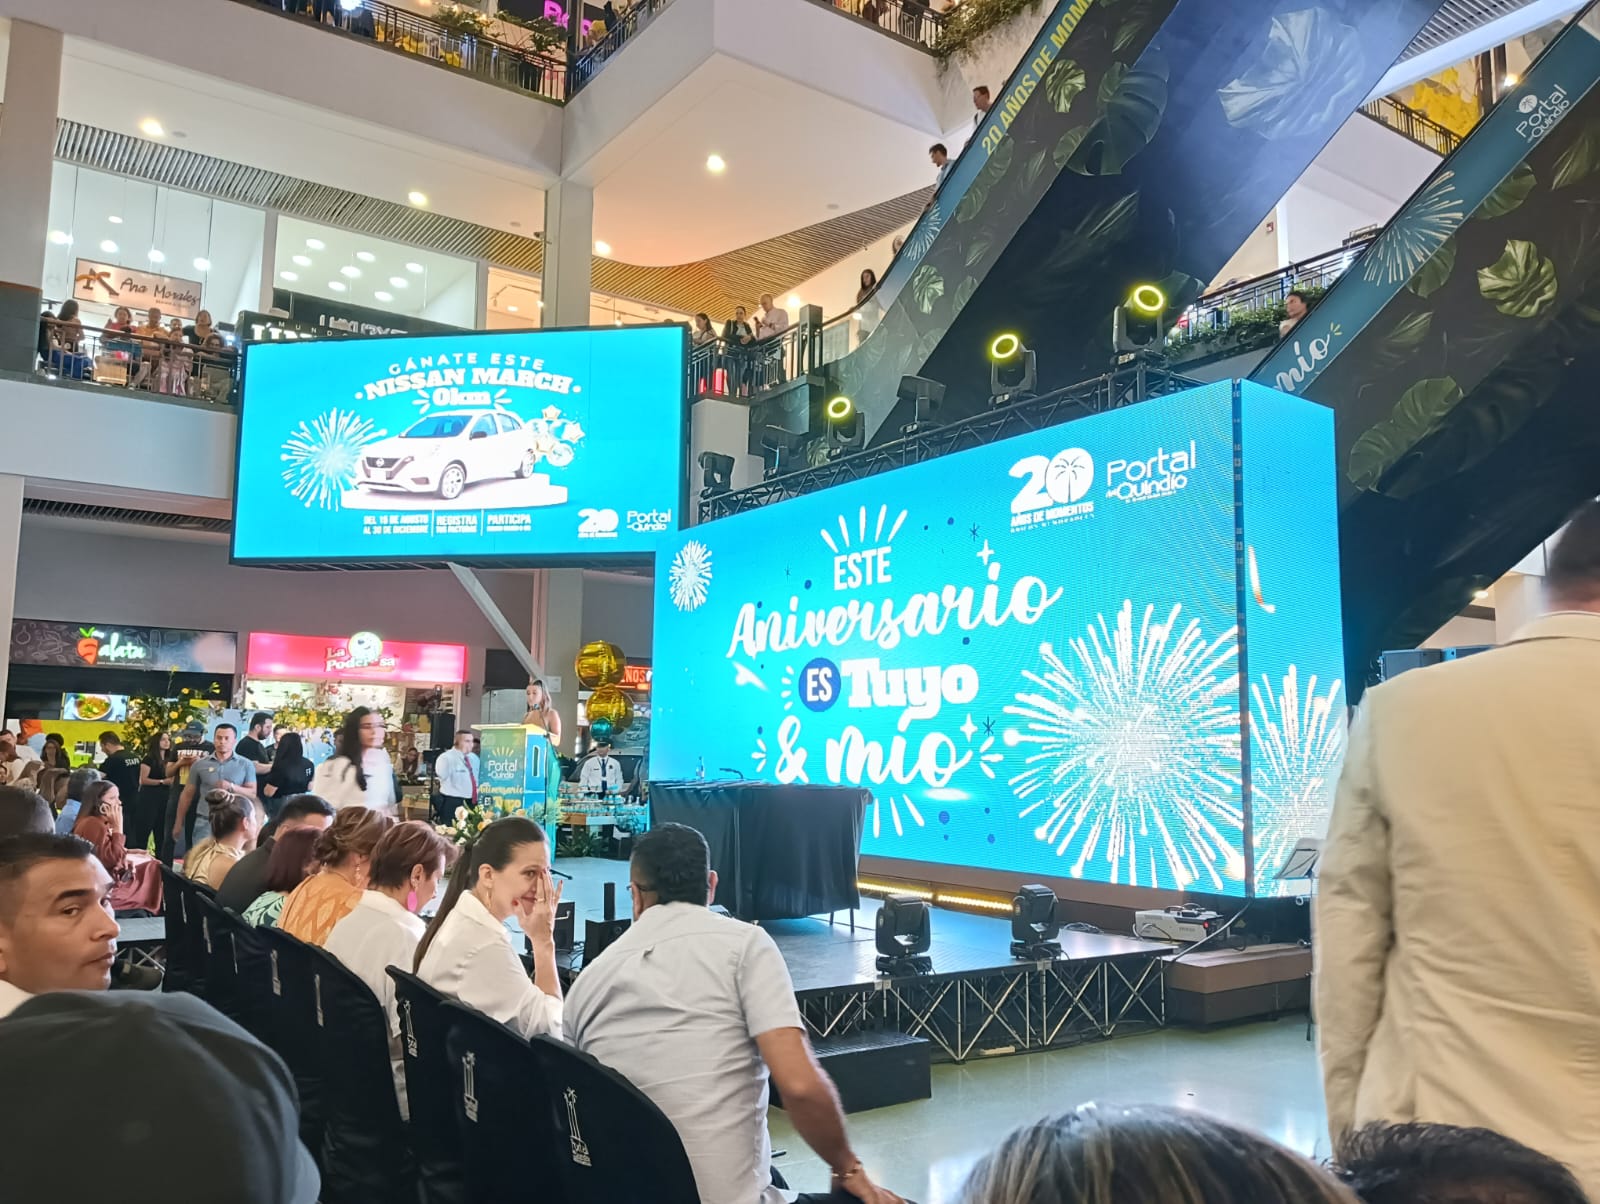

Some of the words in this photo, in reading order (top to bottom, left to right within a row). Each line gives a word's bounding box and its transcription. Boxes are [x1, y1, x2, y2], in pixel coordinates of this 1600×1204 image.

[982, 125, 1003, 156] 20
[1000, 74, 1037, 130] AÑOS
[1031, 45, 1053, 78] DE
[1515, 83, 1567, 138] Portal
[119, 277, 149, 294] Ana
[153, 284, 199, 306] Morales
[278, 321, 348, 337] MUND
[388, 352, 478, 375] GÁNATE
[490, 352, 545, 371] ESTE
[363, 368, 466, 400] NISSAN
[471, 367, 574, 394] MARCH
[1106, 440, 1197, 487] Portal
[1008, 447, 1095, 515] 20
[1116, 473, 1188, 500] Quindío
[487, 514, 532, 525] PARTICIPA
[577, 507, 620, 533] 20
[626, 508, 672, 524] Portal
[834, 546, 892, 591] ESTE
[726, 561, 1064, 660] Aniversario
[325, 647, 347, 659] La
[806, 666, 833, 702] ES
[841, 657, 979, 732] Tuyo
[488, 758, 518, 772] Portal
[775, 715, 809, 784] &
